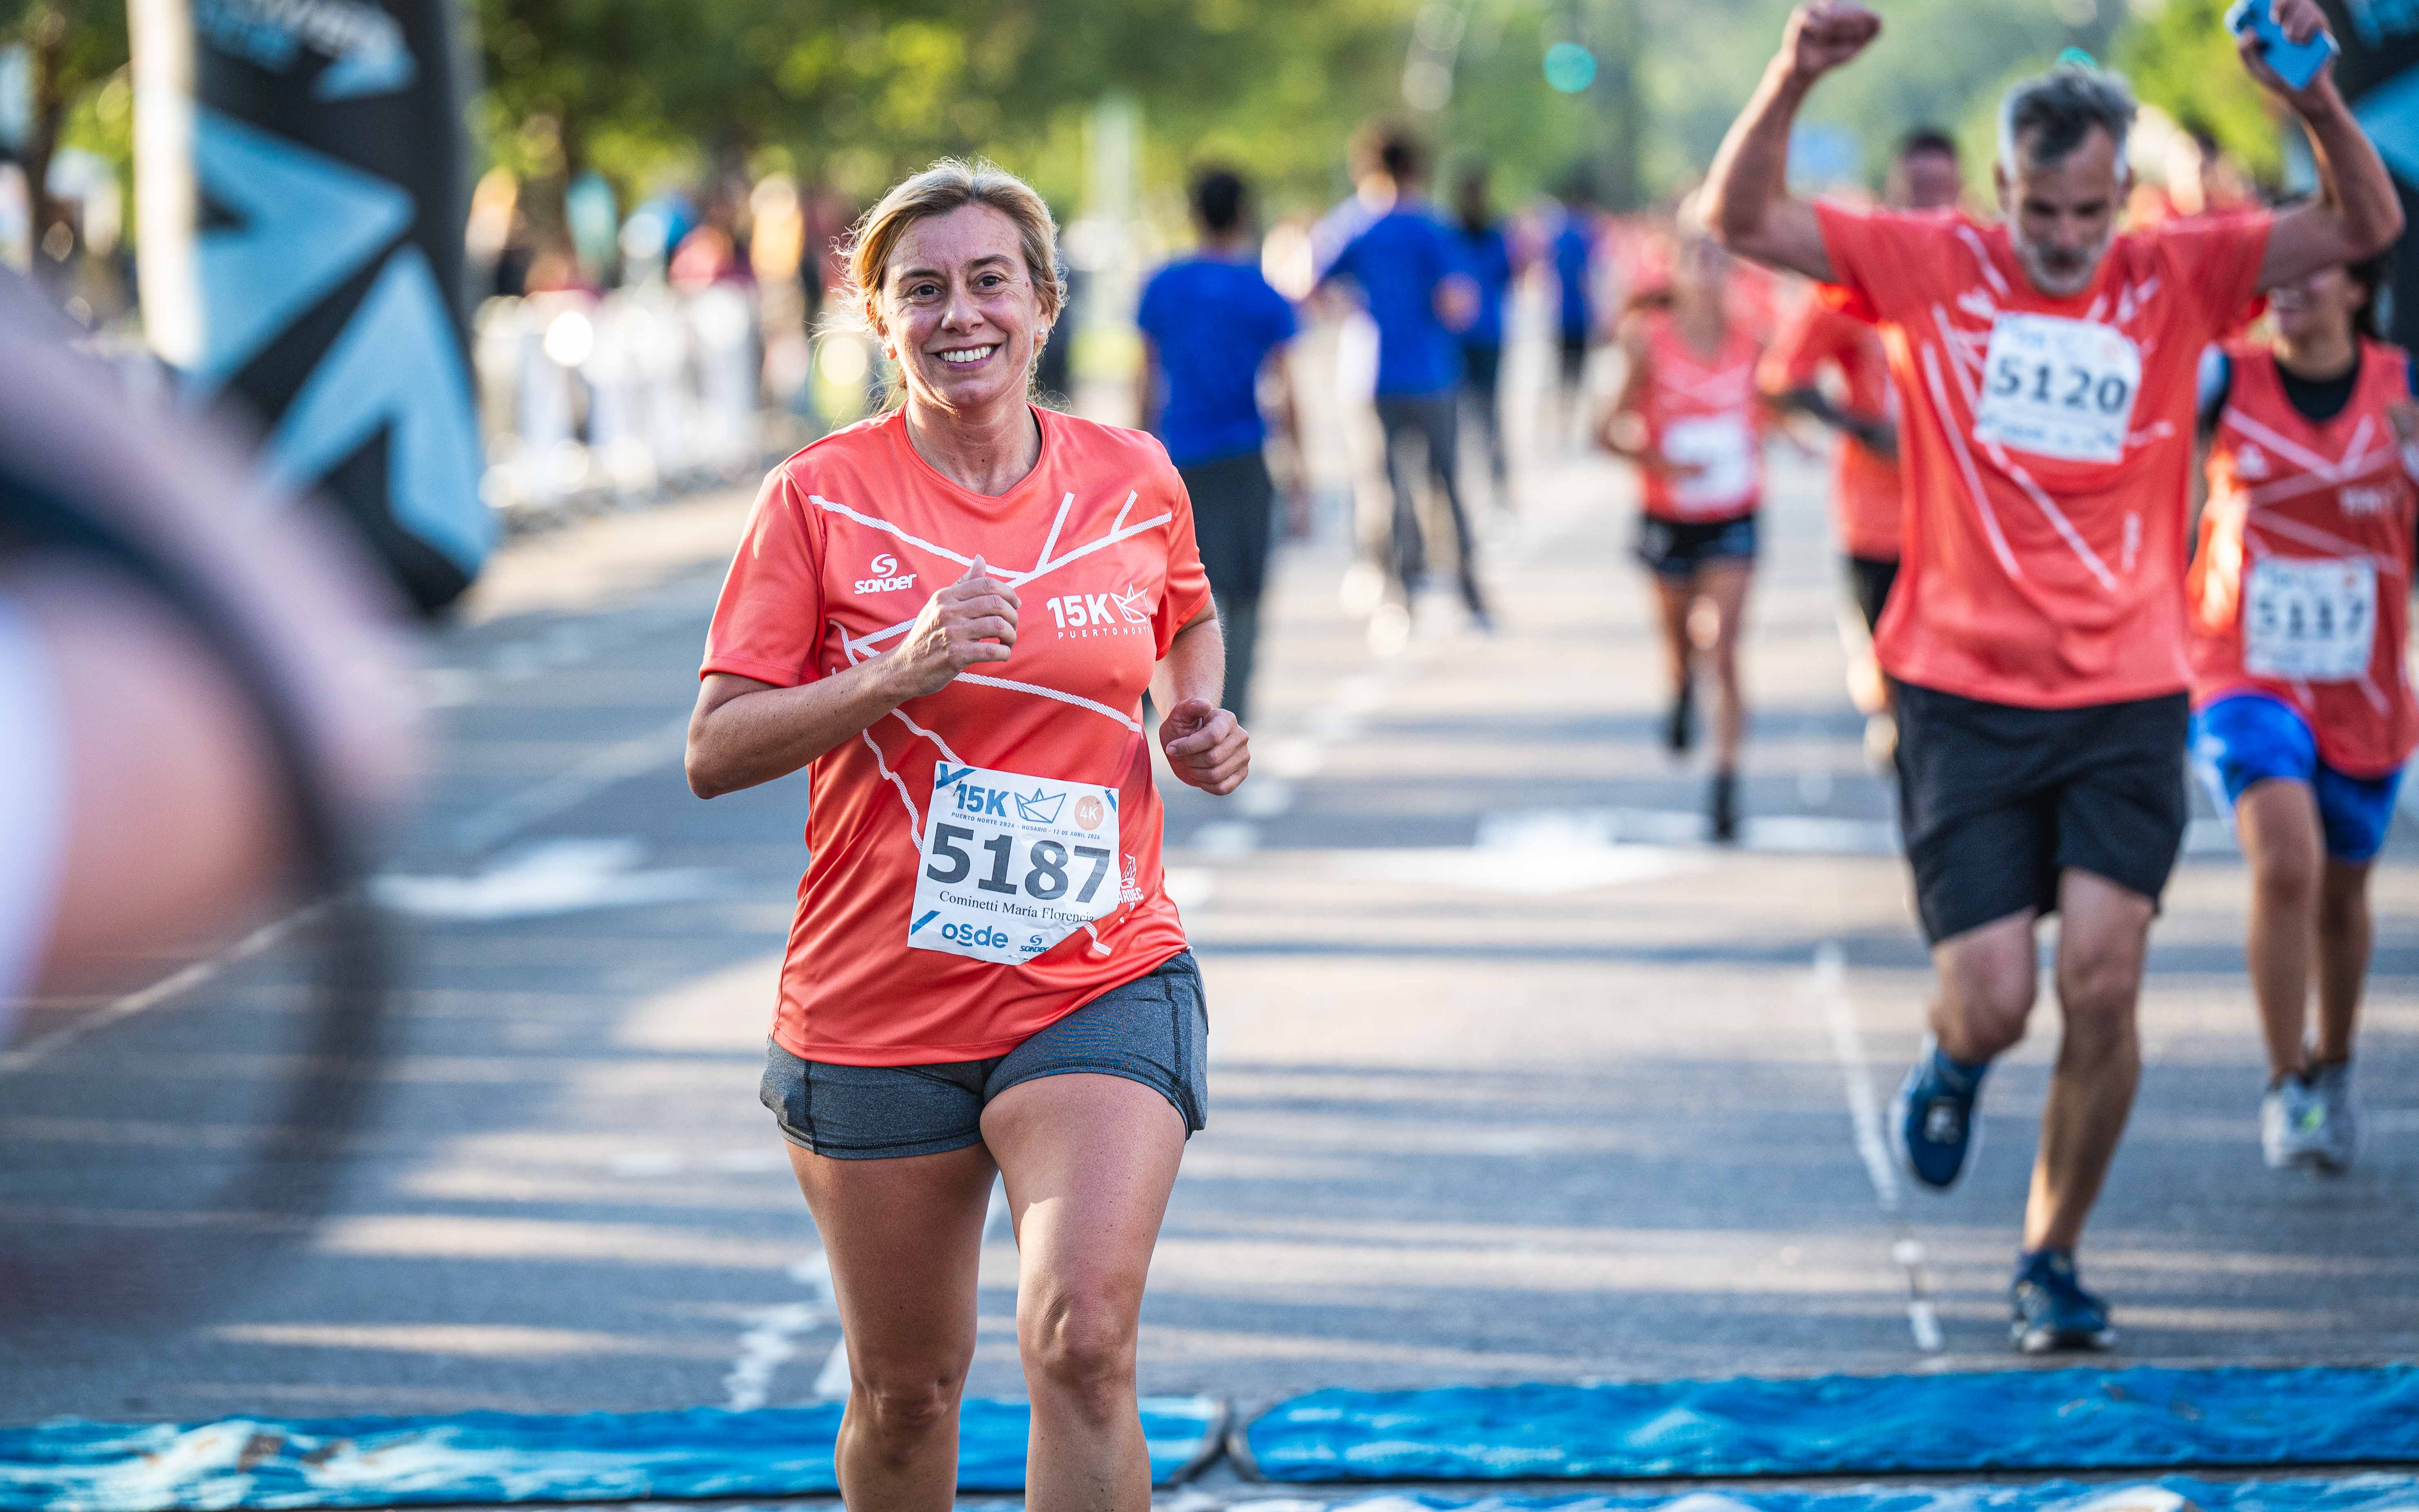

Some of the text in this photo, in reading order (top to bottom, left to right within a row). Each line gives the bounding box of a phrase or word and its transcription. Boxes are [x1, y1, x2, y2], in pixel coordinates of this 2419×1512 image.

[1992, 356, 2128, 414] 5120
[1046, 594, 1115, 628] 15K
[1057, 627, 1117, 639] PUERTO
[956, 784, 1010, 817] 15K
[1080, 806, 1098, 821] 4K
[951, 812, 975, 821] PUERTO
[1022, 824, 1047, 833] ROSARIO
[926, 822, 1110, 904] 5187
[940, 890, 998, 912] Cominetti
[1002, 902, 1037, 918] María
[942, 923, 1008, 948] osde
